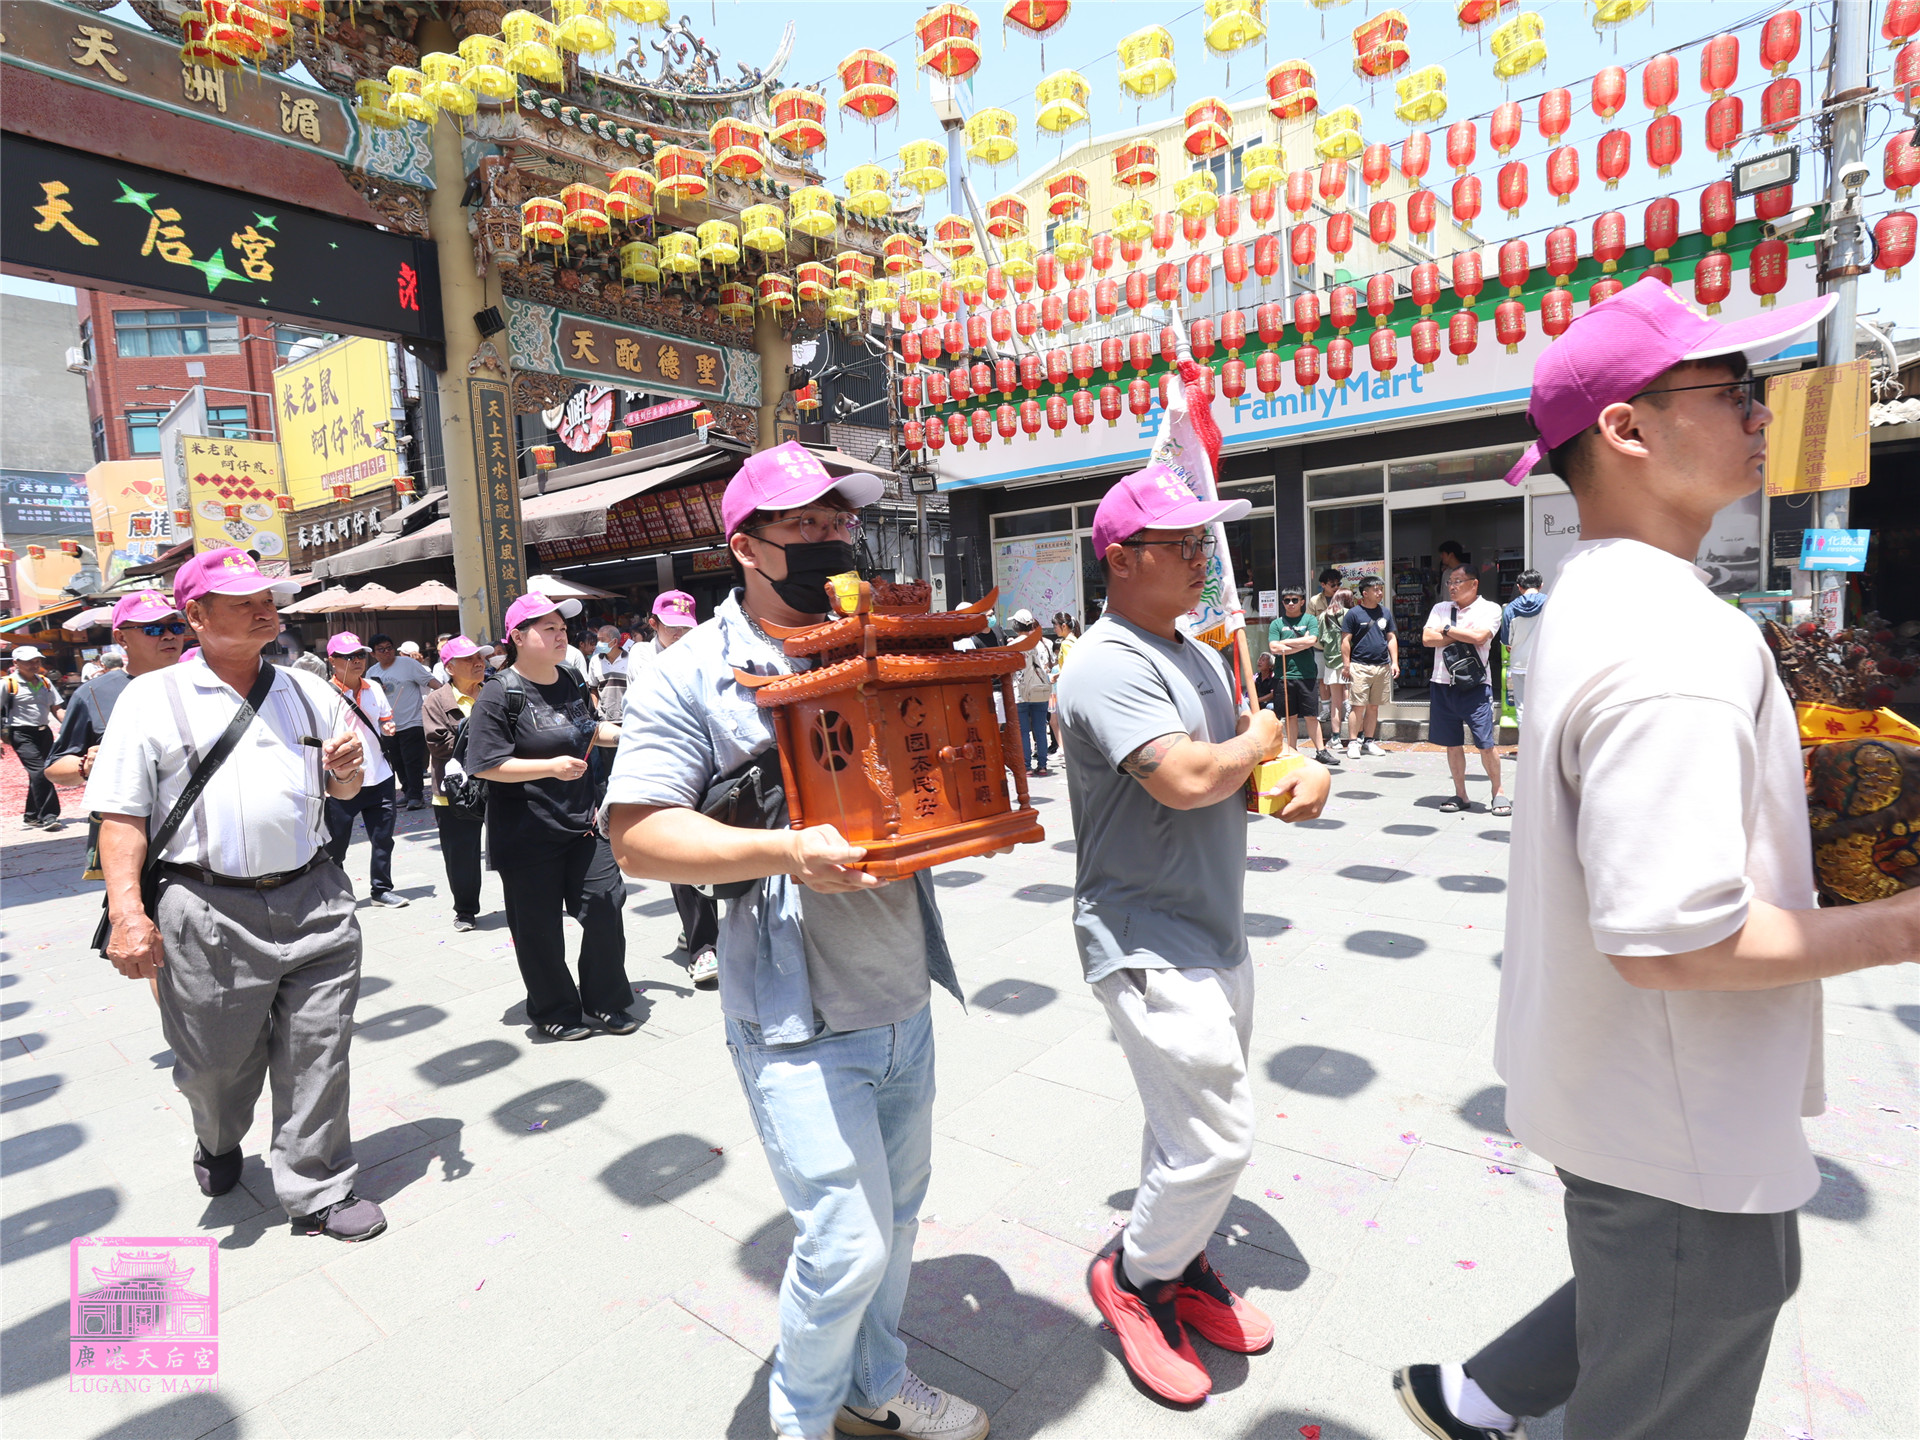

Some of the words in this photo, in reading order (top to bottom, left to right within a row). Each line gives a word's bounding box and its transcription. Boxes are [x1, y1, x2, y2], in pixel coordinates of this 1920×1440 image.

[33, 181, 275, 282] 天后宮
[283, 368, 339, 422] 米老鼠
[1234, 364, 1424, 424] FamilyMart
[1791, 370, 1842, 391] 歡迎
[191, 442, 238, 458] 米老鼠
[1805, 385, 1827, 487] 各界蒞臨本宮進香
[1828, 535, 1866, 546] 化妝室
